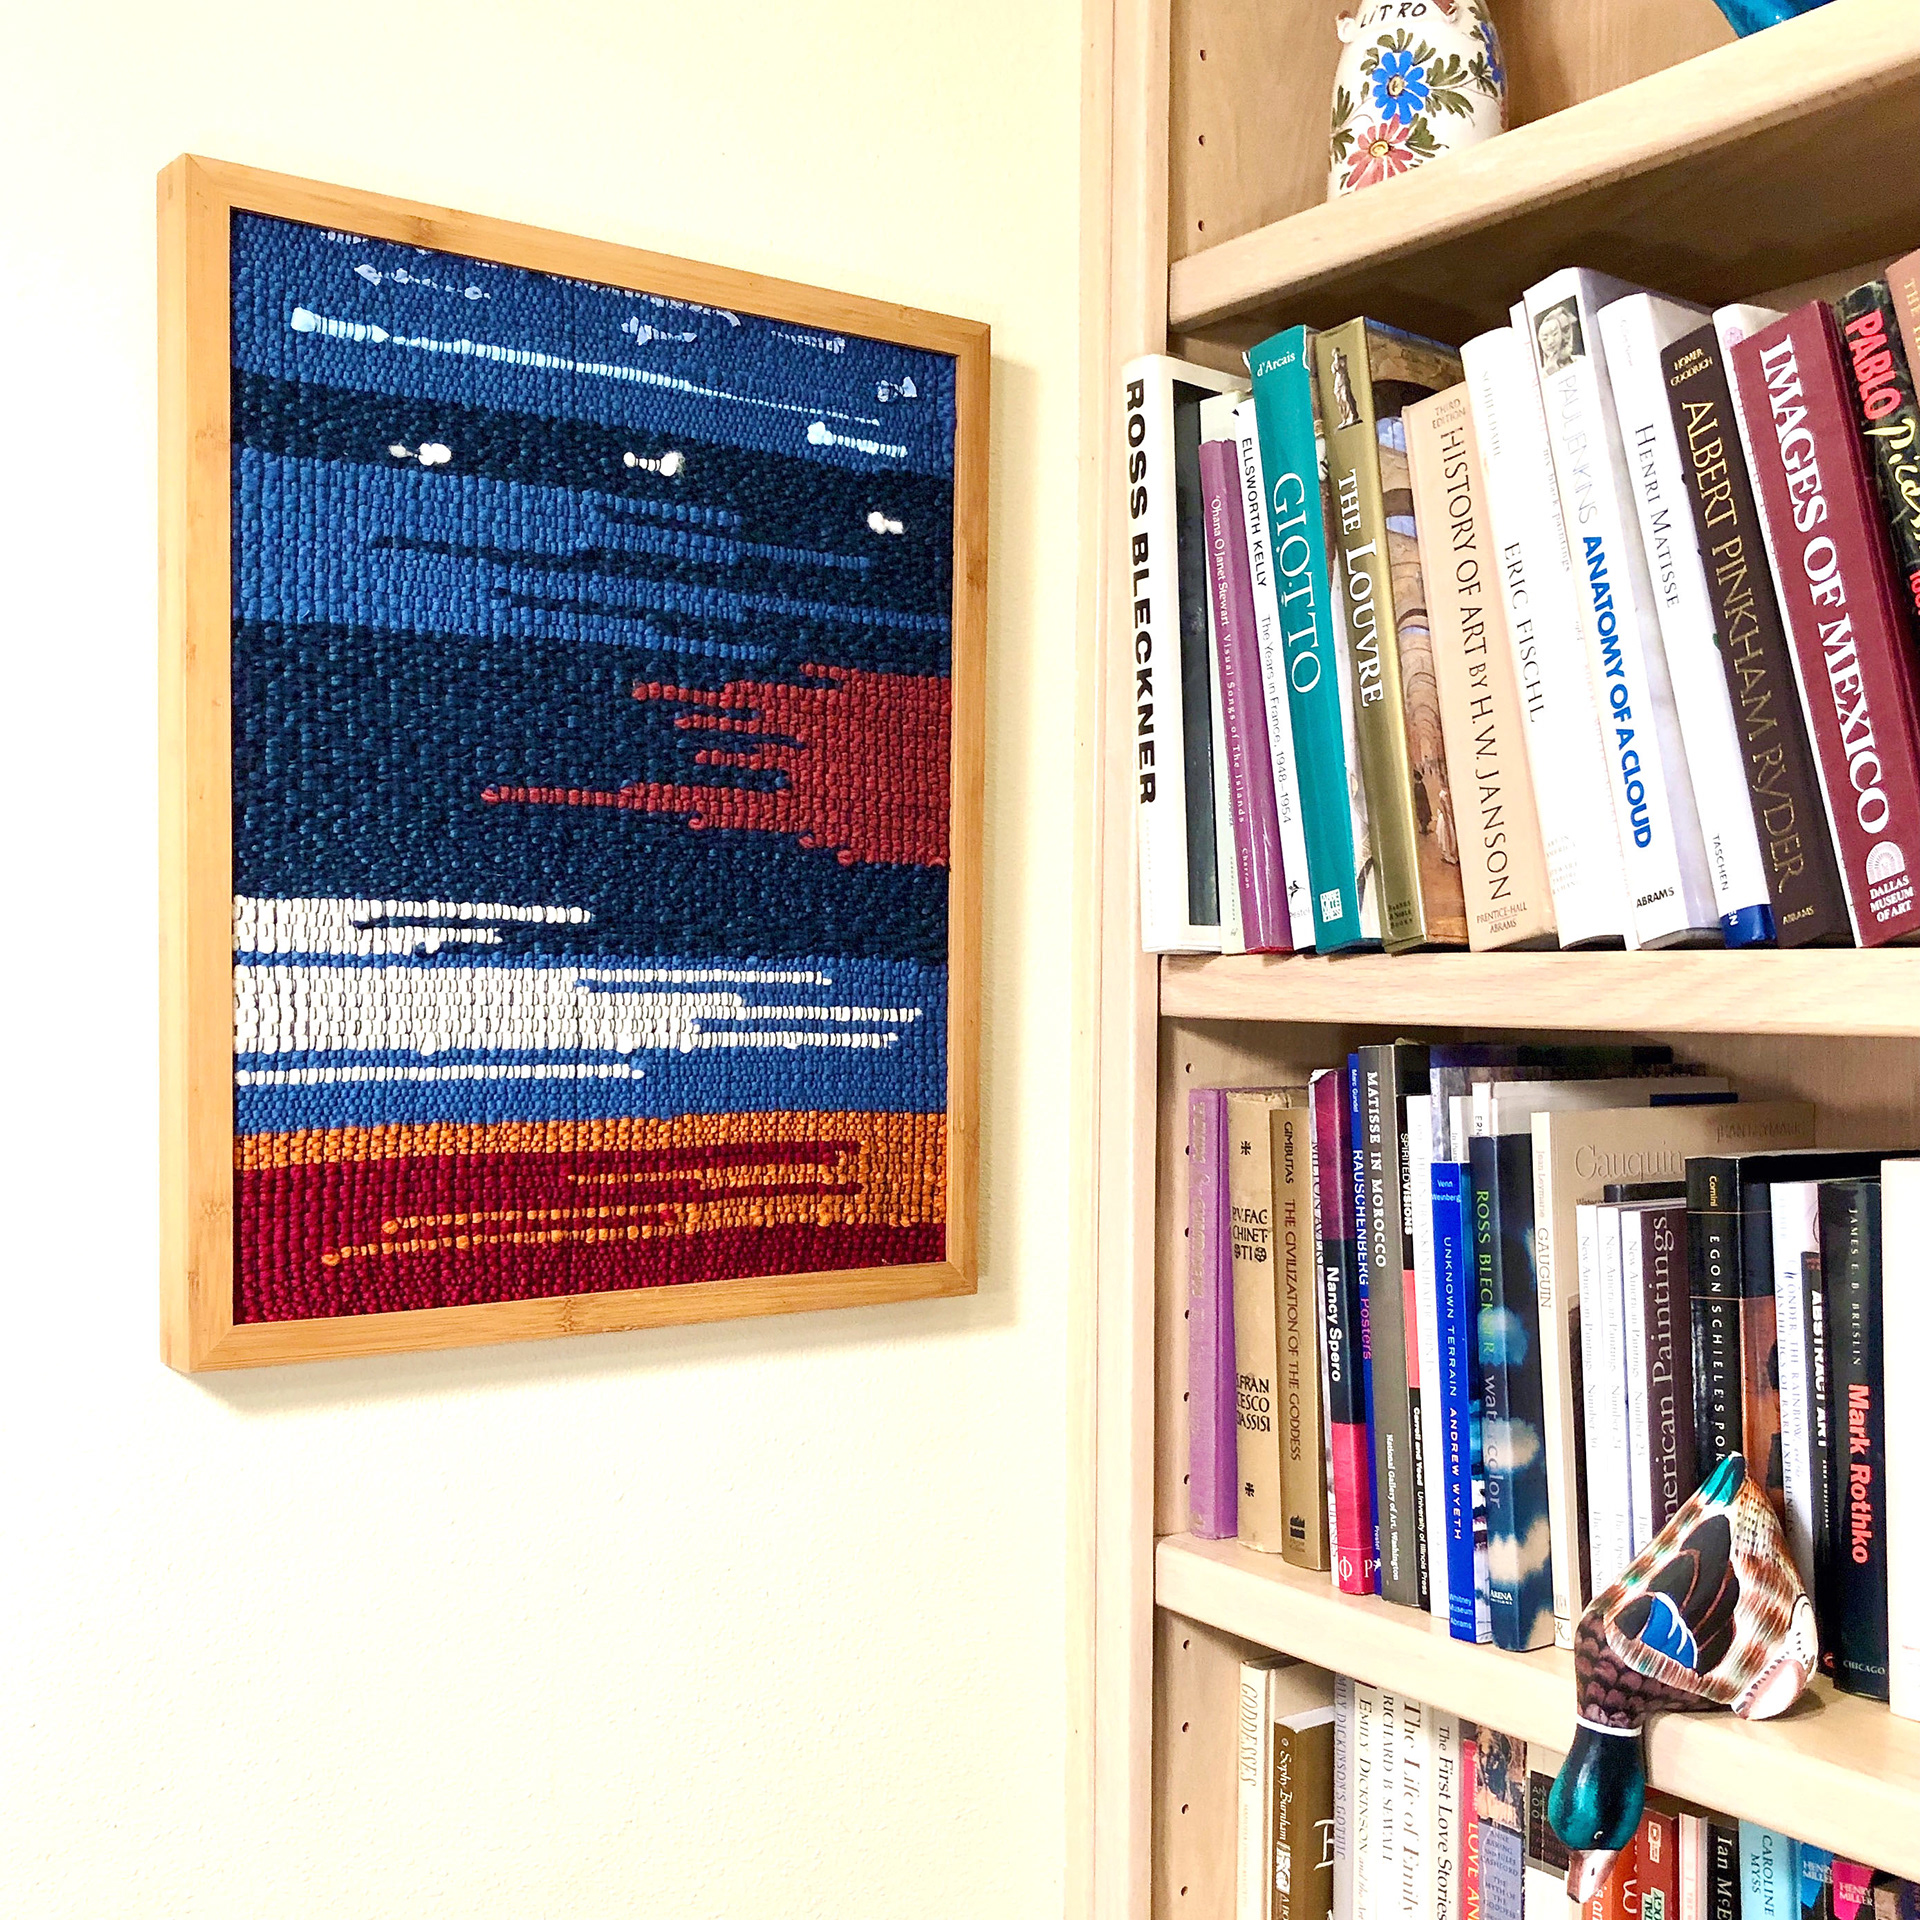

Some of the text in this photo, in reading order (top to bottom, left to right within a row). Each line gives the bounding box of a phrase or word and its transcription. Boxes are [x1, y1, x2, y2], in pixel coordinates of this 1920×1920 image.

[1256, 351, 1296, 378] d'Arcais
[1670, 356, 1713, 386] GOODRICH
[1673, 347, 1703, 371] HOMER
[1845, 308, 1902, 420] PABLO
[1432, 408, 1466, 429] EDITION
[1434, 398, 1461, 416] THIRD
[1558, 374, 1583, 428] PAUL
[1242, 437, 1261, 535] ELLSWORTH
[1562, 432, 1598, 524] JENKINS
[1338, 468, 1362, 535] THE
[1635, 424, 1680, 608] HENRI MATISSE
[1214, 552, 1227, 580] Janet
[1253, 540, 1267, 587] KELLY
[1273, 472, 1321, 693] GIOTTO
[1759, 333, 1890, 834] IMAGES OF MEXICO
[1125, 378, 1157, 804] ROSS BLECKNER
[1218, 582, 1230, 627] Stewart
[1583, 537, 1625, 678] ANATOMY
[1261, 614, 1271, 641] The
[1504, 542, 1544, 722] ERIC FISCHL
[1681, 401, 1738, 528] ALBERT
[1712, 535, 1778, 741] PINKHAM
[1752, 742, 1804, 893] RYDER
[1223, 633, 1234, 676] Visual
[1264, 642, 1275, 680] Years
[1441, 426, 1511, 900] HISTORY OF ART BY H. W. JANSON
[1227, 681, 1236, 720] Songs
[1267, 681, 1276, 695] in
[1610, 684, 1632, 722] OF
[1231, 726, 1240, 739] of
[1270, 696, 1281, 747] France,
[1615, 729, 1635, 751] A
[1233, 744, 1241, 768] The
[1235, 774, 1246, 823] Islands
[1621, 750, 1652, 848] CLOUD
[1712, 834, 1729, 891] TASCHEN
[1636, 887, 1675, 908] ABRAMS
[1869, 875, 1910, 900] DALLAS
[1870, 886, 1914, 913] MUSEUM
[1476, 902, 1528, 924] PRENTICE-HALL
[1489, 919, 1517, 934] ABRAMS
[1782, 905, 1815, 925] ABRAMS
[1876, 900, 1912, 922] OF ART
[1284, 1121, 1294, 1184] GIMBUTAS
[1367, 1071, 1386, 1268] MATISSE IN MOROCCO
[1575, 1140, 1684, 1182] Gauguin
[1709, 1175, 1718, 1207] Comini
[1476, 1190, 1491, 1243] ROSS
[1352, 1149, 1371, 1359] RAUSCHENBERG Posters
[1537, 1227, 1551, 1308] GAUGUIN
[1649, 1216, 1675, 1387] Paintings
[1848, 1208, 1861, 1366] JAMES E. B. BRESLIN
[1285, 1199, 1301, 1461] THE CIVILIZATION OF THE GODDESS
[1327, 1267, 1342, 1382] Nancy Spero
[1709, 1235, 1725, 1413] EGON SCHIELE'S
[1443, 1237, 1462, 1540] UNKNOWN TERRAIN ANDREW WYETH
[1413, 1407, 1421, 1440] Carroll
[1848, 1383, 1873, 1564] Mark Rothko
[1386, 1434, 1399, 1580] National Gallery of Washington
[1417, 1491, 1425, 1532] University
[1419, 1532, 1425, 1542] of
[1450, 1604, 1473, 1616] Museum
[1491, 1590, 1513, 1600] ARENA
[1450, 1617, 1472, 1629] Abrams
[1843, 1660, 1886, 1675] CHICAGO
[1241, 1682, 1258, 1786] GODDESSES
[1402, 1701, 1422, 1748] The
[1277, 1750, 1292, 1788] Sophy
[1335, 1675, 1348, 1860] MILY DICKINSON'S GOTHIC
[1359, 1698, 1373, 1853] EMILY DICKINSON
[1382, 1694, 1395, 1861] RICHARD SEWALL
[1404, 1757, 1421, 1804] Life
[1279, 1790, 1293, 1841] Burnham
[1403, 1811, 1419, 1841] of
[1437, 1725, 1453, 1920] The First Love Stories
[1466, 1821, 1480, 1878] LOVE
[1717, 1836, 1733, 1869] Ian
[1803, 1860, 1833, 1876] HENRY
[1486, 1881, 1505, 1896] MYTH
[1493, 1876, 1506, 1887] THE
[1750, 1853, 1762, 1893] MYSS
[1762, 1835, 1775, 1917] CAROLINE
[1802, 1869, 1834, 1884] MILLER
[1839, 1881, 1872, 1898] HENRY
[1493, 1894, 1506, 1906] THE
[1839, 1891, 1874, 1906] MILLER
